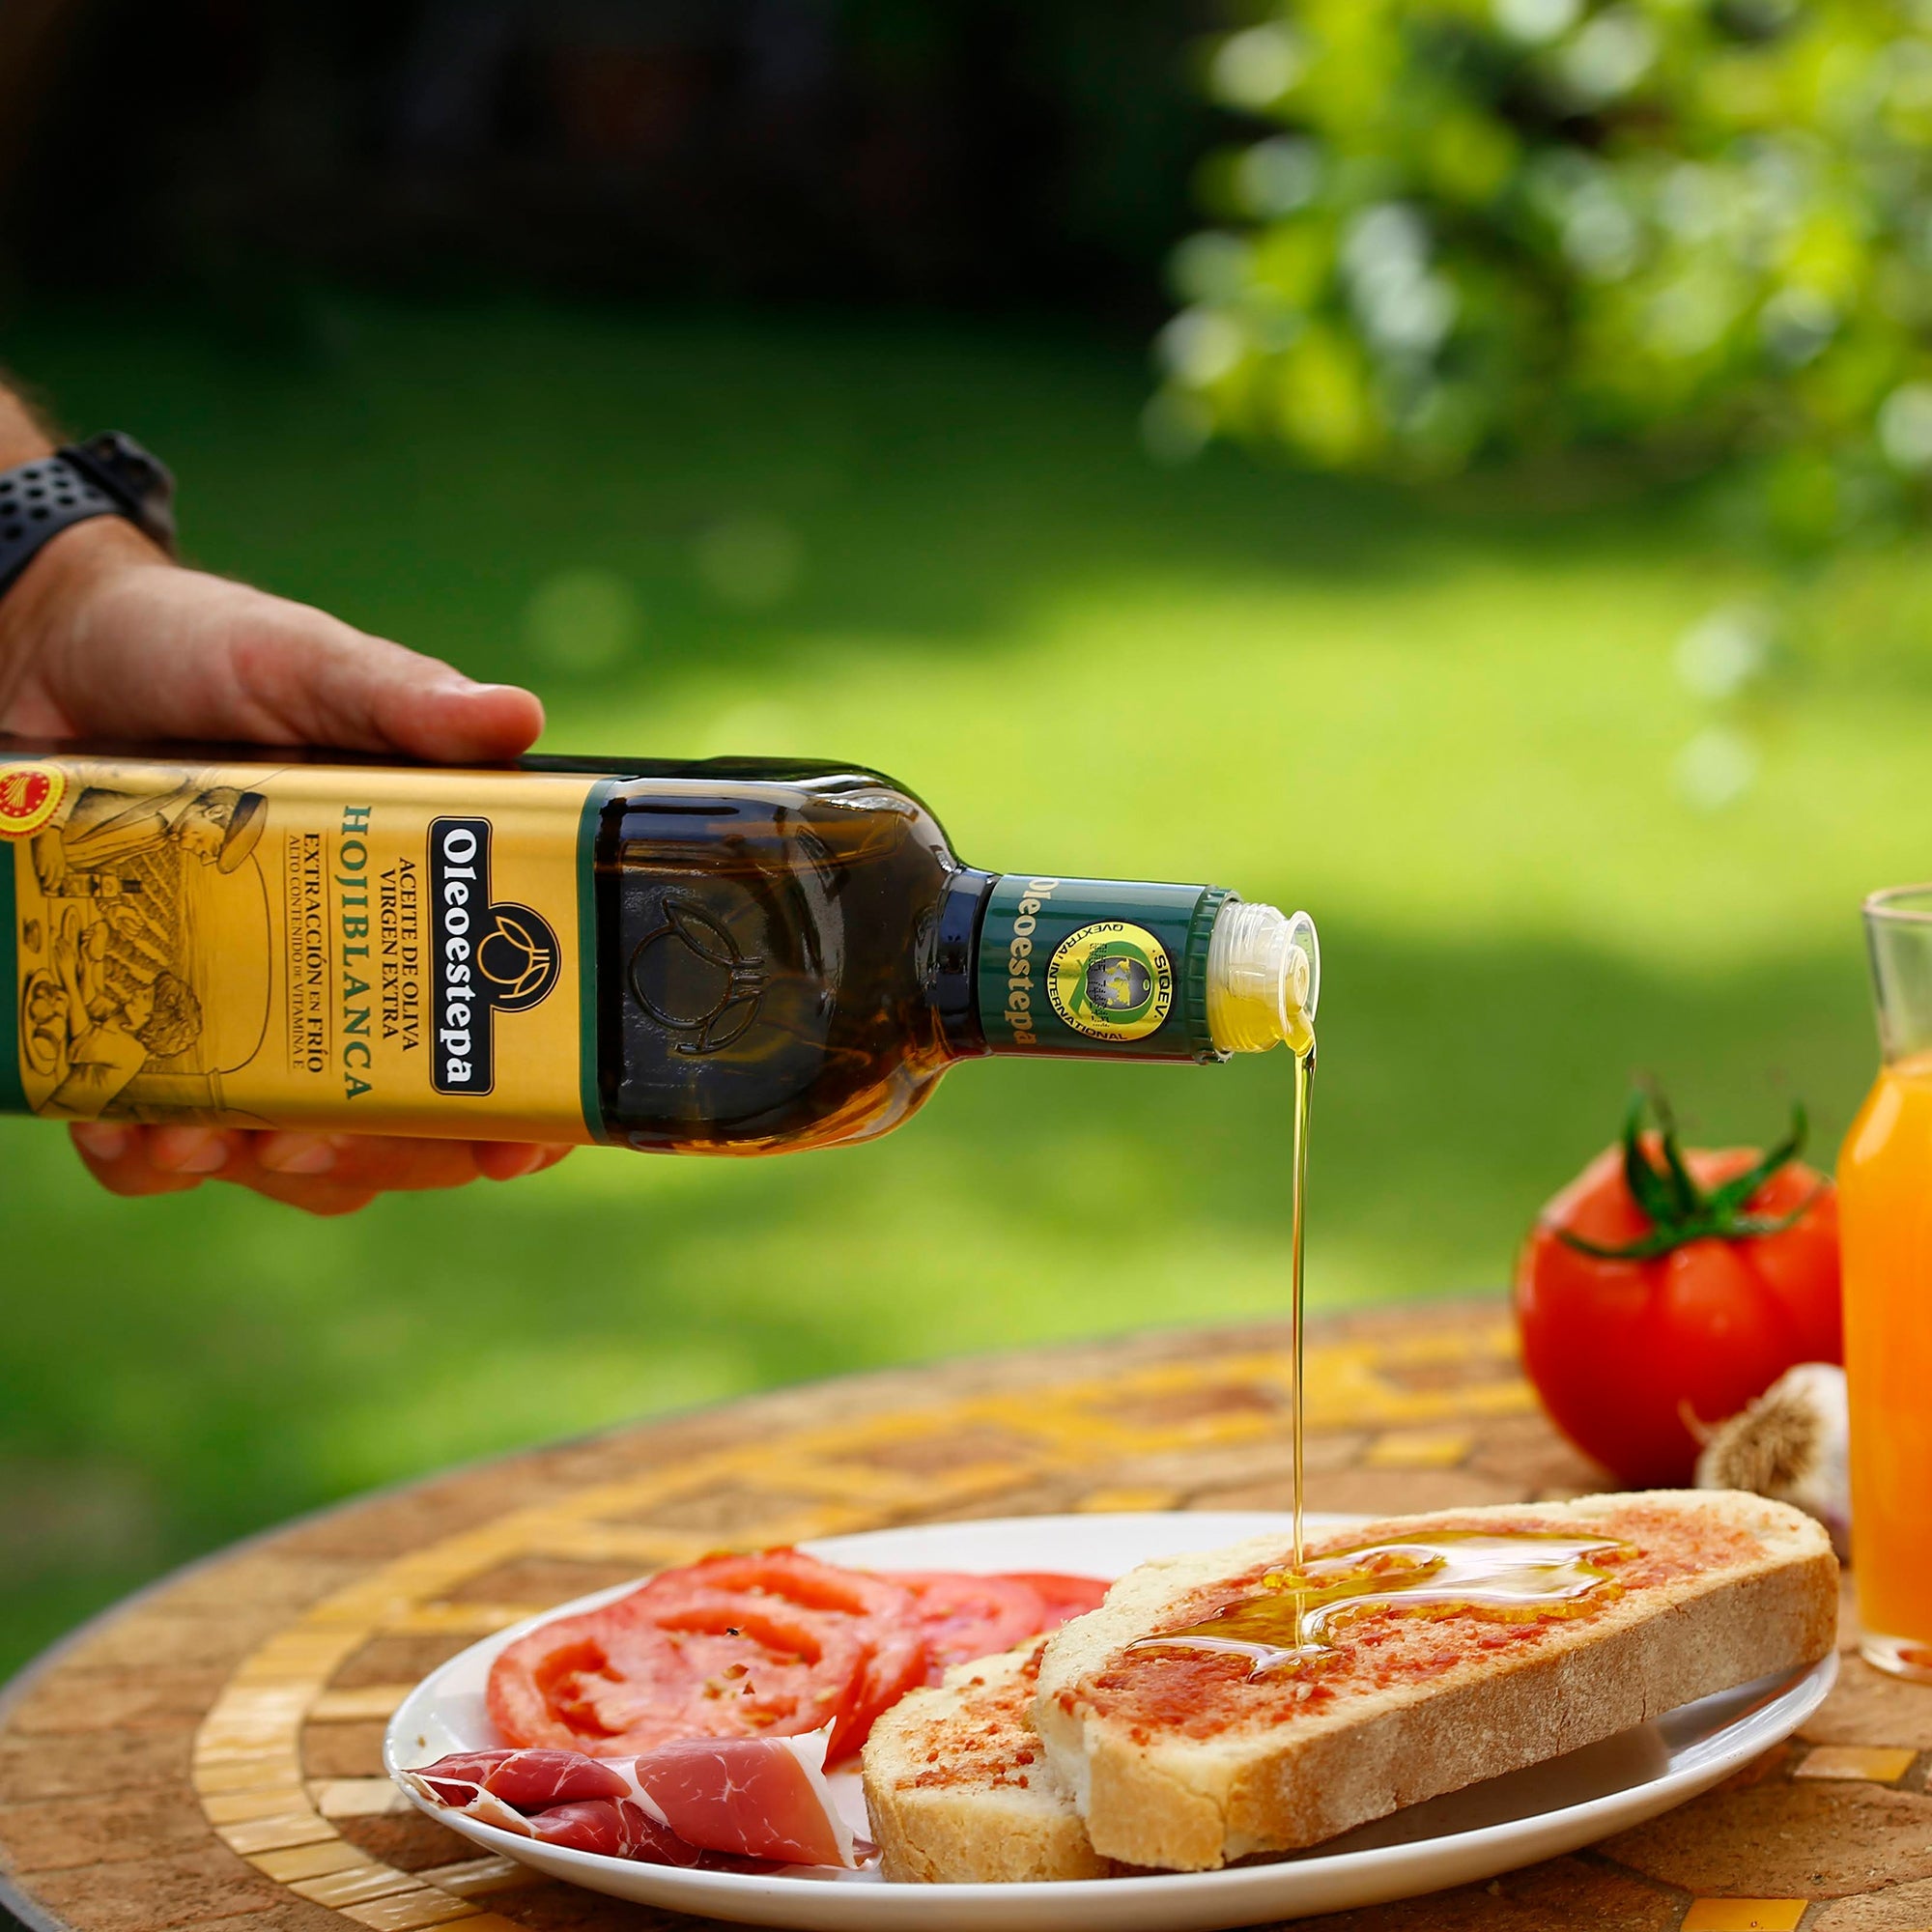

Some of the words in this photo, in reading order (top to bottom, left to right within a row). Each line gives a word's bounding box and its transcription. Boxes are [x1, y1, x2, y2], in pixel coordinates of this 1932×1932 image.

[289, 835, 300, 873] ALTO
[290, 876, 303, 963] CONTENIDO
[304, 833, 327, 985] EXTRACCIÓN
[380, 869, 398, 956] VIRGEN
[399, 857, 418, 942] ACEITE
[334, 806, 373, 1100] HOJIBLANCA
[401, 944, 418, 976] DE
[440, 828, 477, 1083] Oleoestepa
[1004, 878, 1060, 1045] Oleoestepa
[1058, 923, 1123, 959] QVEXTRA!
[292, 982, 304, 1056] VITAMINA
[309, 991, 321, 1011] EN
[382, 962, 399, 1039] EXTRA
[402, 979, 419, 1052] OLIVA
[1049, 962, 1127, 1040] INTERNATIONAL
[293, 1060, 304, 1069] E
[306, 1017, 328, 1073] FRÍO
